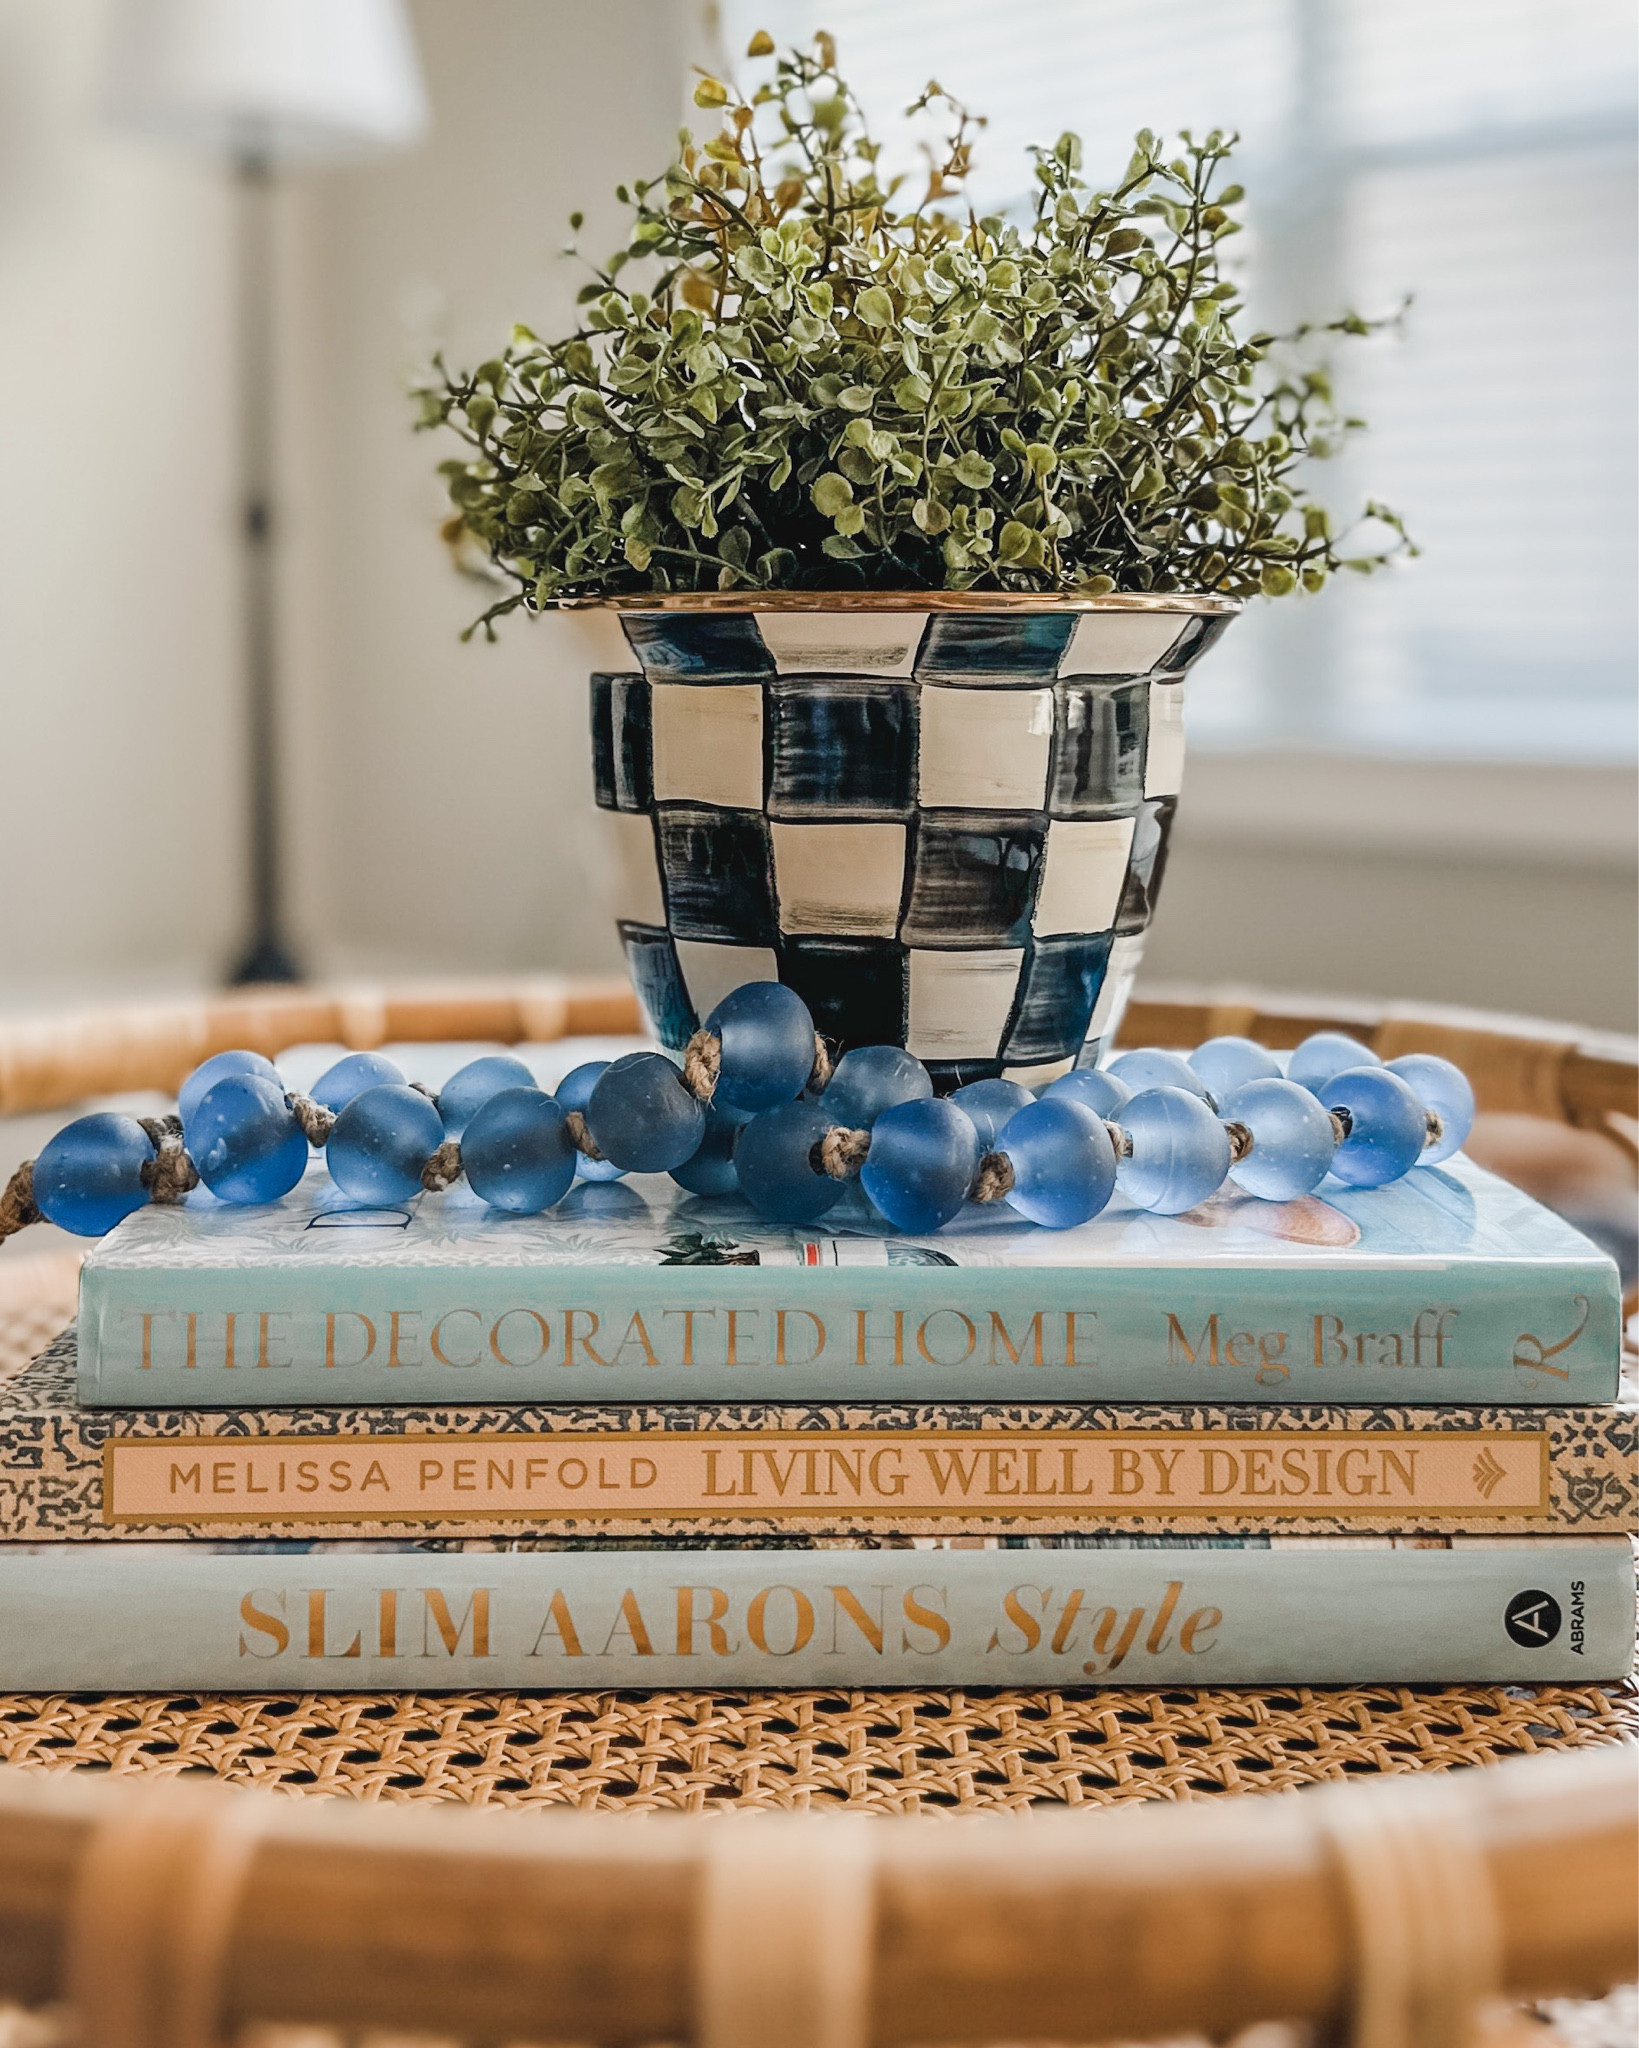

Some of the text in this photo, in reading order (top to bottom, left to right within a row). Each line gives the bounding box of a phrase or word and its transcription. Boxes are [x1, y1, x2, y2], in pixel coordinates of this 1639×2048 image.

[120, 1308, 1100, 1369] THE DECORATED HOME
[1163, 1308, 1459, 1386] Meg Braff
[169, 1456, 660, 1494] MELISSA PENFOLD
[700, 1446, 1419, 1497] LIVING WELL BY DESIGN
[237, 1583, 952, 1659] SLIM AARONS
[986, 1579, 1225, 1676] Style
[1569, 1579, 1585, 1656] ABRAMS
